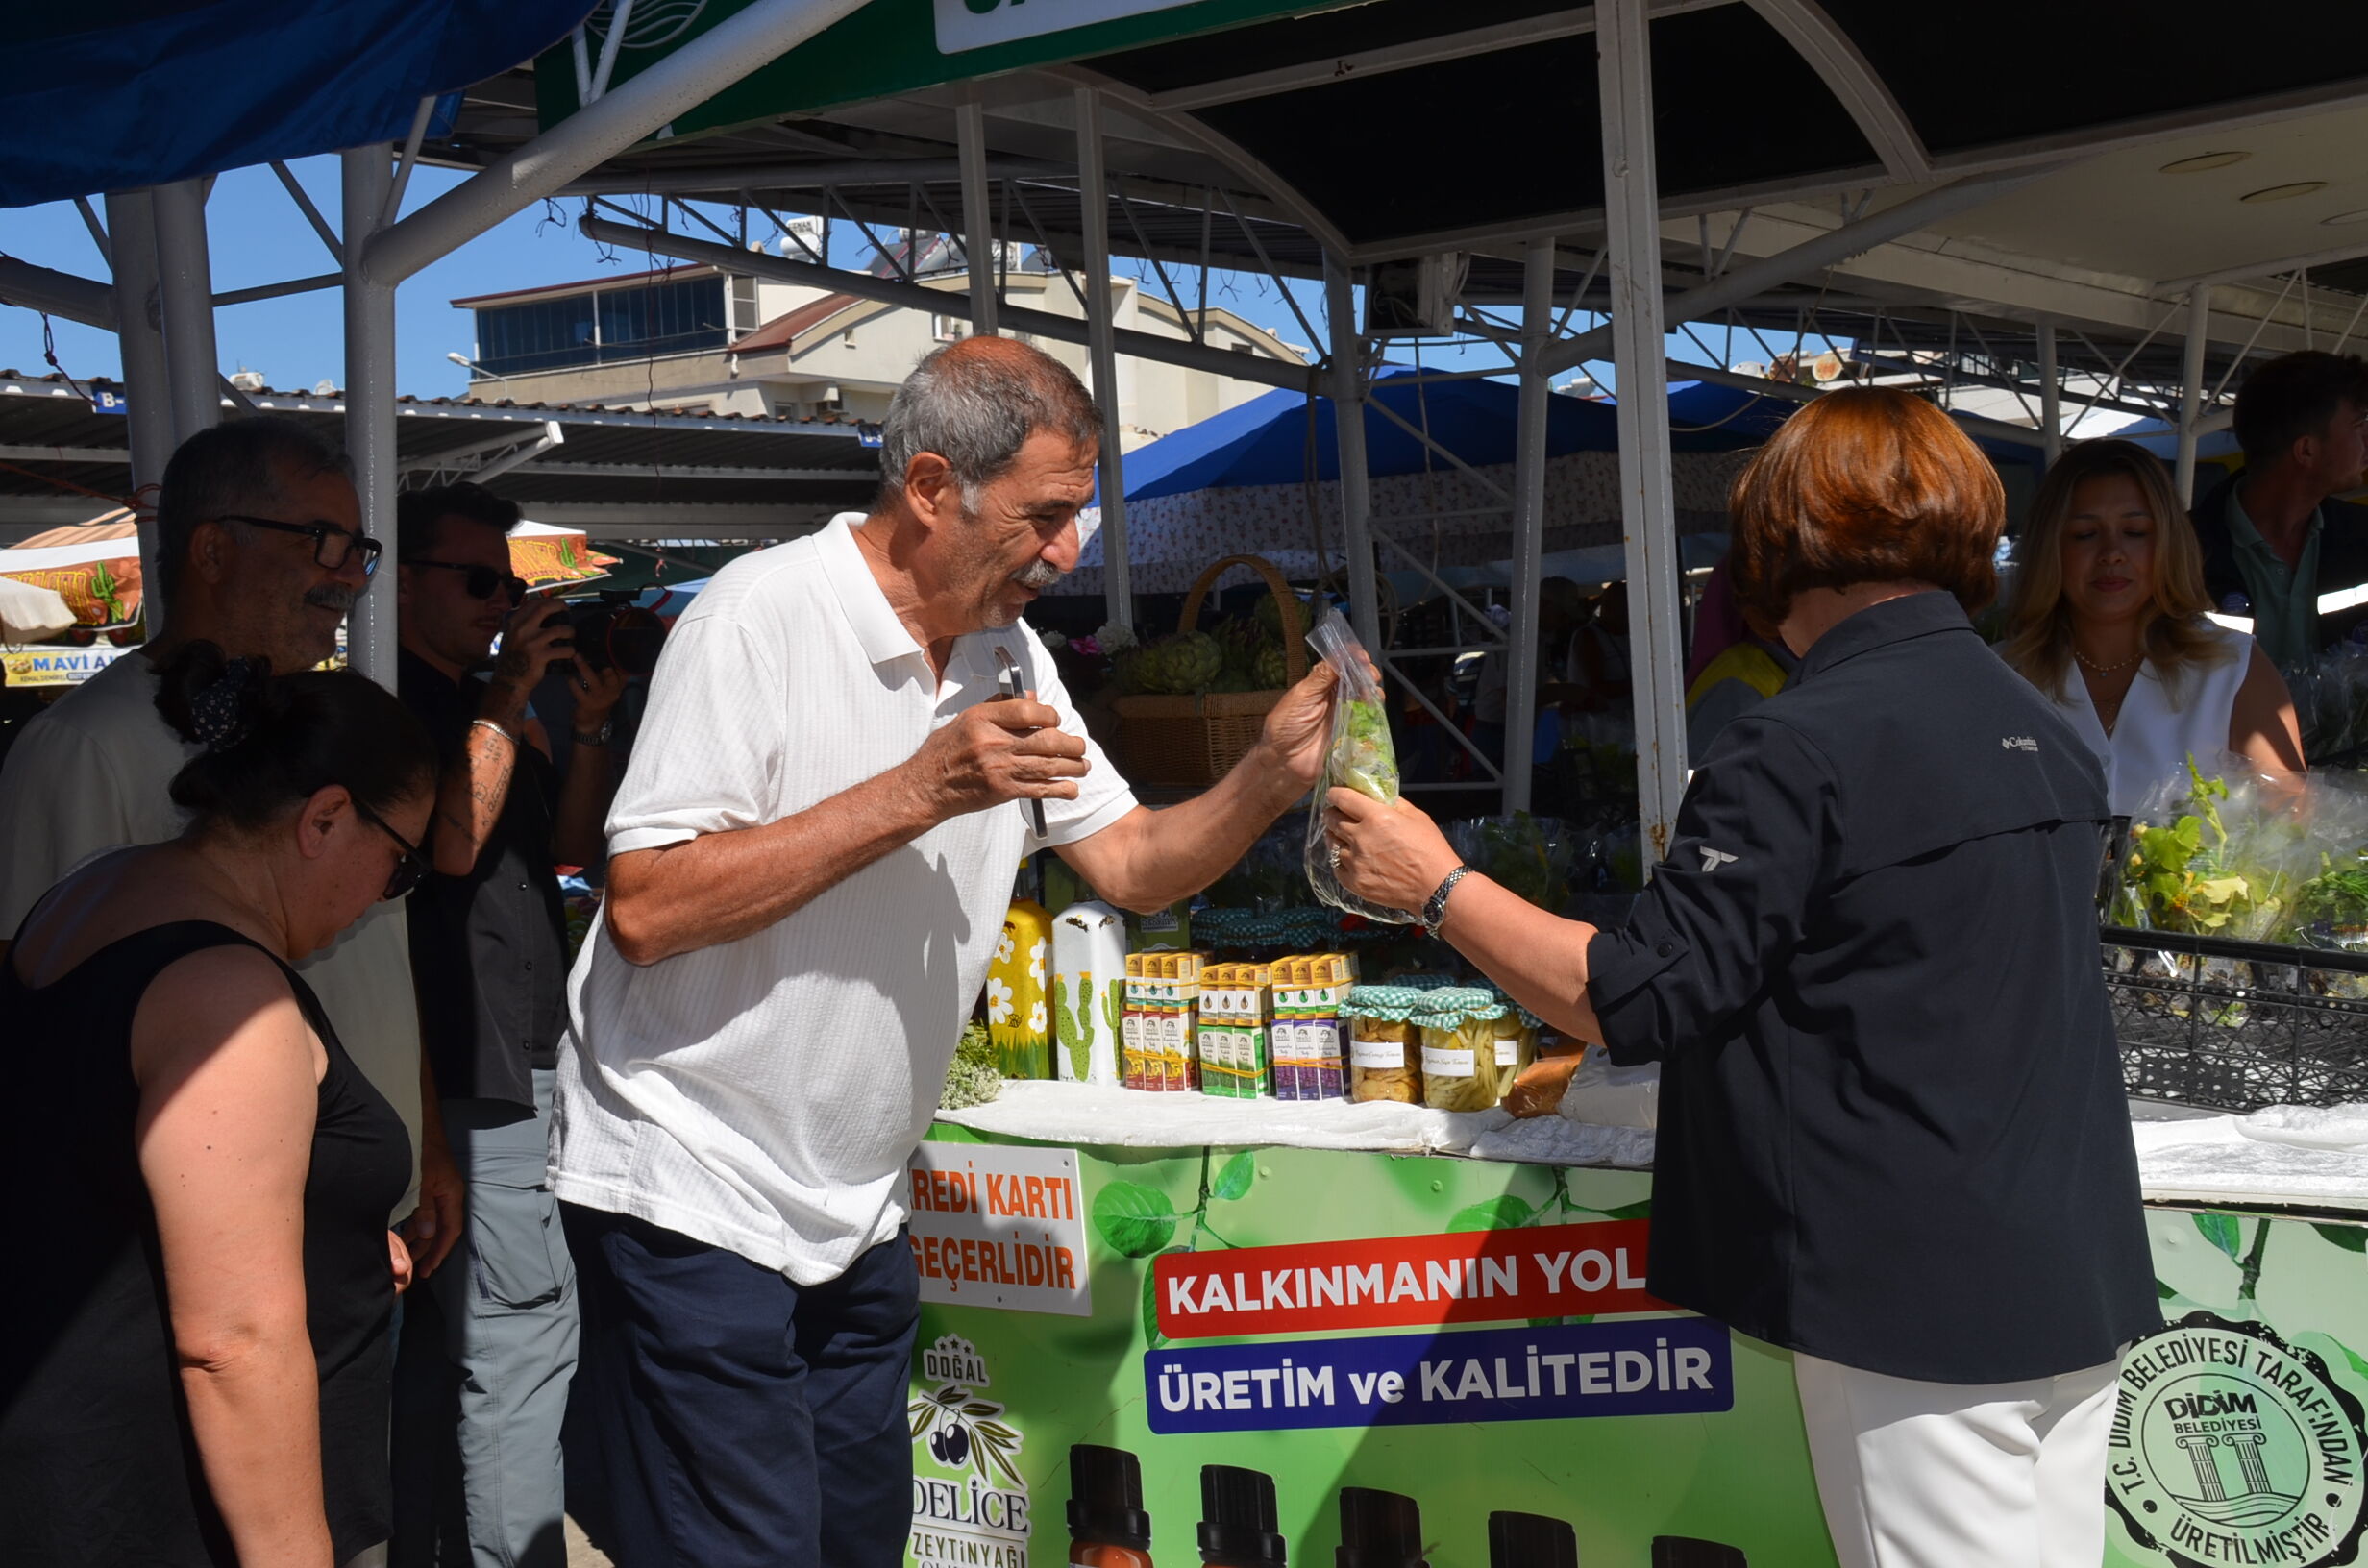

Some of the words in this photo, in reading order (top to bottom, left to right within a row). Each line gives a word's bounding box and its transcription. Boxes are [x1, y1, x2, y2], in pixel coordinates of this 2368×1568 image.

[33, 653, 88, 671] MAVİ
[909, 1160, 978, 1214] REDİ
[985, 1173, 1073, 1220] KARTI
[1168, 1254, 1518, 1314] KALKINMANIN
[927, 1353, 986, 1383] DOĞAL
[1159, 1358, 1335, 1412] ÜRETİM
[1348, 1370, 1405, 1405] ve
[1420, 1337, 1714, 1402] KALİTEDİR
[2121, 1333, 2249, 1391] BELEDİYESİ
[2254, 1350, 2353, 1487] TARAFINDAN
[2163, 1389, 2257, 1421] DİDİM
[2173, 1415, 2262, 1434] BELEDİYESİ
[913, 1532, 1024, 1568] ZEYTİNYAĞI
[2169, 1512, 2330, 1565] ÜRETİLMİŞTİR
